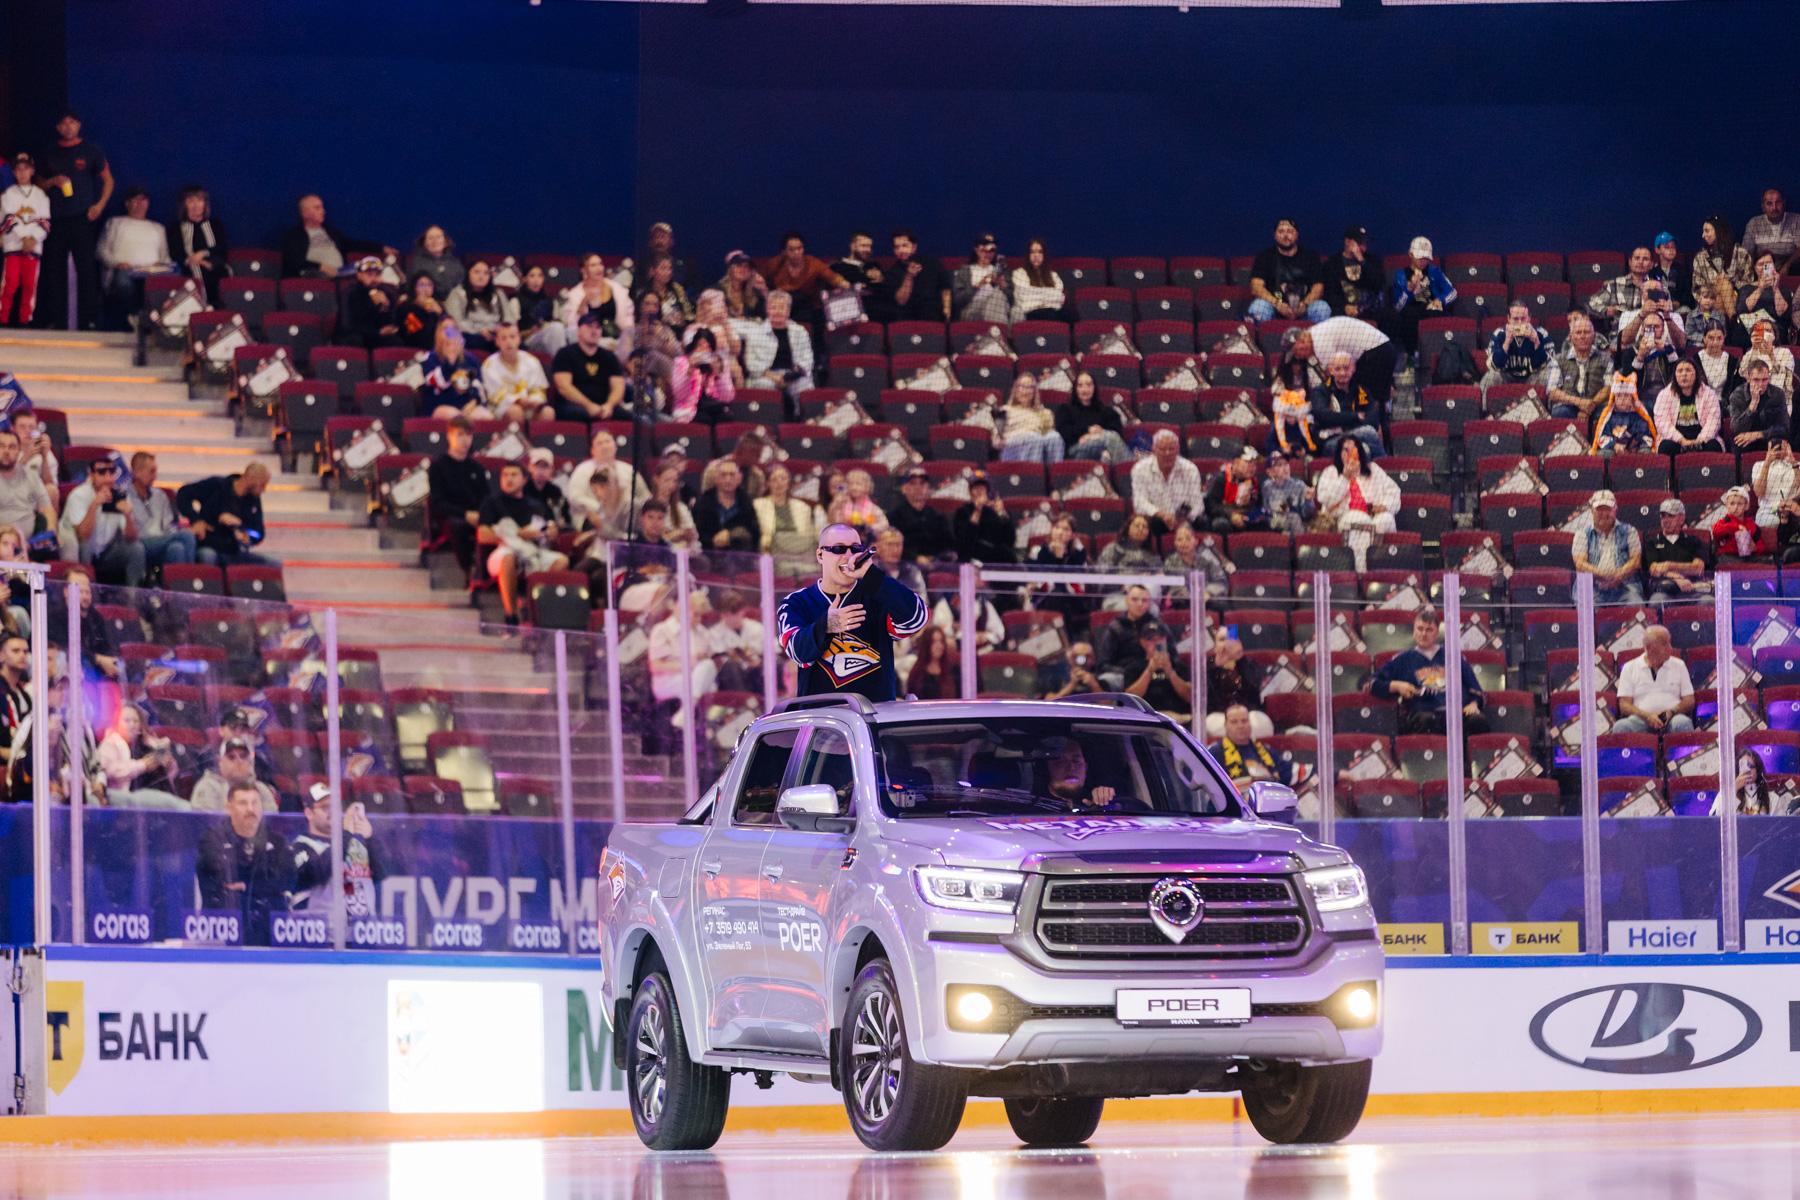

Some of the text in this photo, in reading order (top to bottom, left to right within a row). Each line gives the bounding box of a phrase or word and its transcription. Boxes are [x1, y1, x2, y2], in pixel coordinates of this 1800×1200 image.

[778, 921, 823, 953] POER
[1383, 934, 1427, 945] БАНК
[1494, 933, 1560, 944] Т БАНК
[1628, 926, 1697, 948] Haier
[1147, 998, 1219, 1012] POER
[98, 1012, 209, 1061] БАНК
